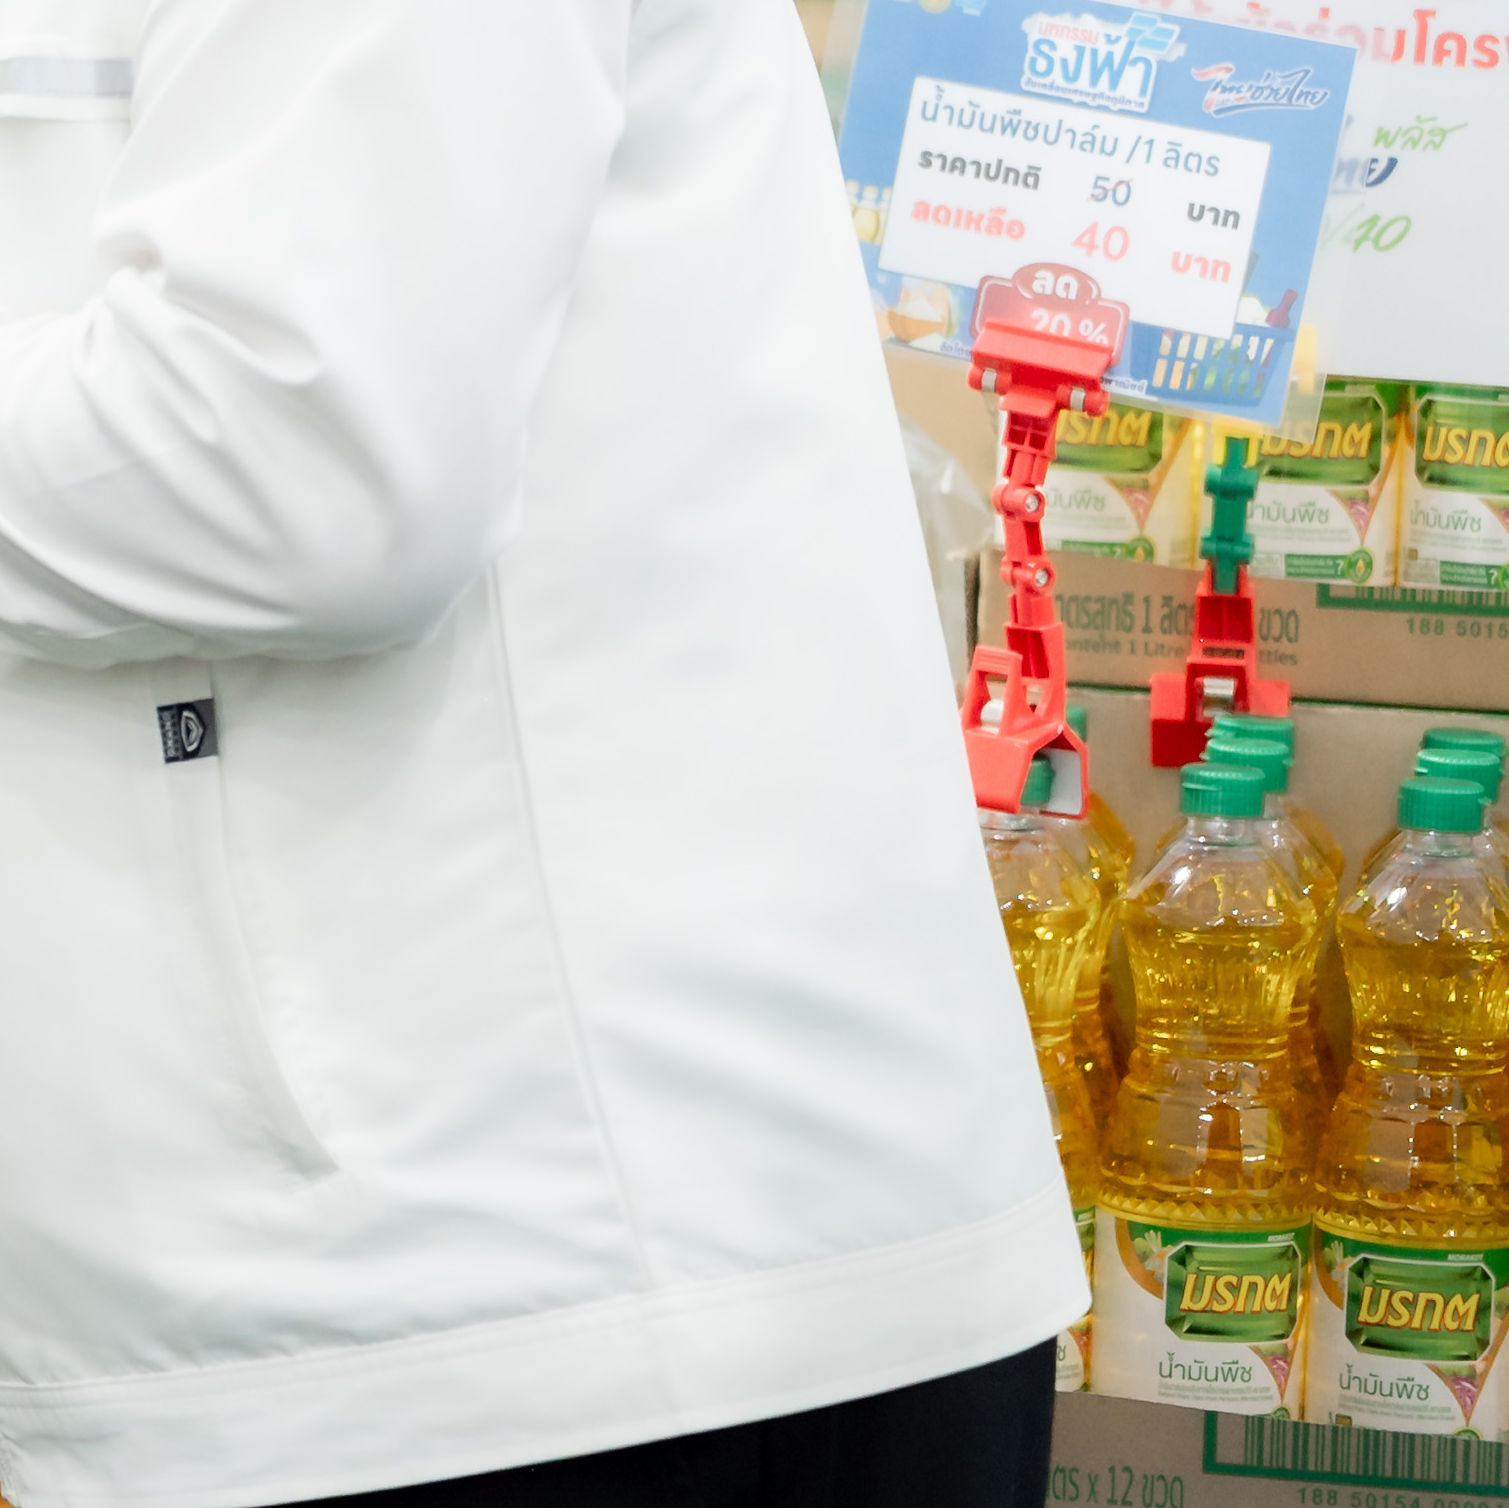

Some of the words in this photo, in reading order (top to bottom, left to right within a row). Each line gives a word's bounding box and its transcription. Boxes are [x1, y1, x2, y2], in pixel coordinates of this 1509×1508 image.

[1028, 33, 1154, 100] ธงฟ้า
[920, 85, 1119, 158] น้ำมันพืชปาล์ม
[1162, 141, 1221, 178] ลิตร
[918, 148, 1042, 191] ราคาปกติ
[1089, 175, 1133, 207] 50
[1186, 201, 1241, 230] บาท
[910, 199, 1026, 242] ลดเหลือ
[1071, 221, 1130, 262] 40
[1171, 250, 1231, 283] บาท
[1031, 269, 1079, 301] ลด
[1160, 594, 1195, 637] ลิต
[1407, 617, 1445, 636] 188
[1179, 1272, 1293, 1315] มรกต
[1356, 1285, 1481, 1333] มรกต
[1158, 1351, 1253, 1383] น้ำมันพืช
[1338, 1362, 1430, 1402] น้ำมันพืช
[1107, 1464, 1134, 1506] 12
[1297, 1487, 1338, 1506] 188
